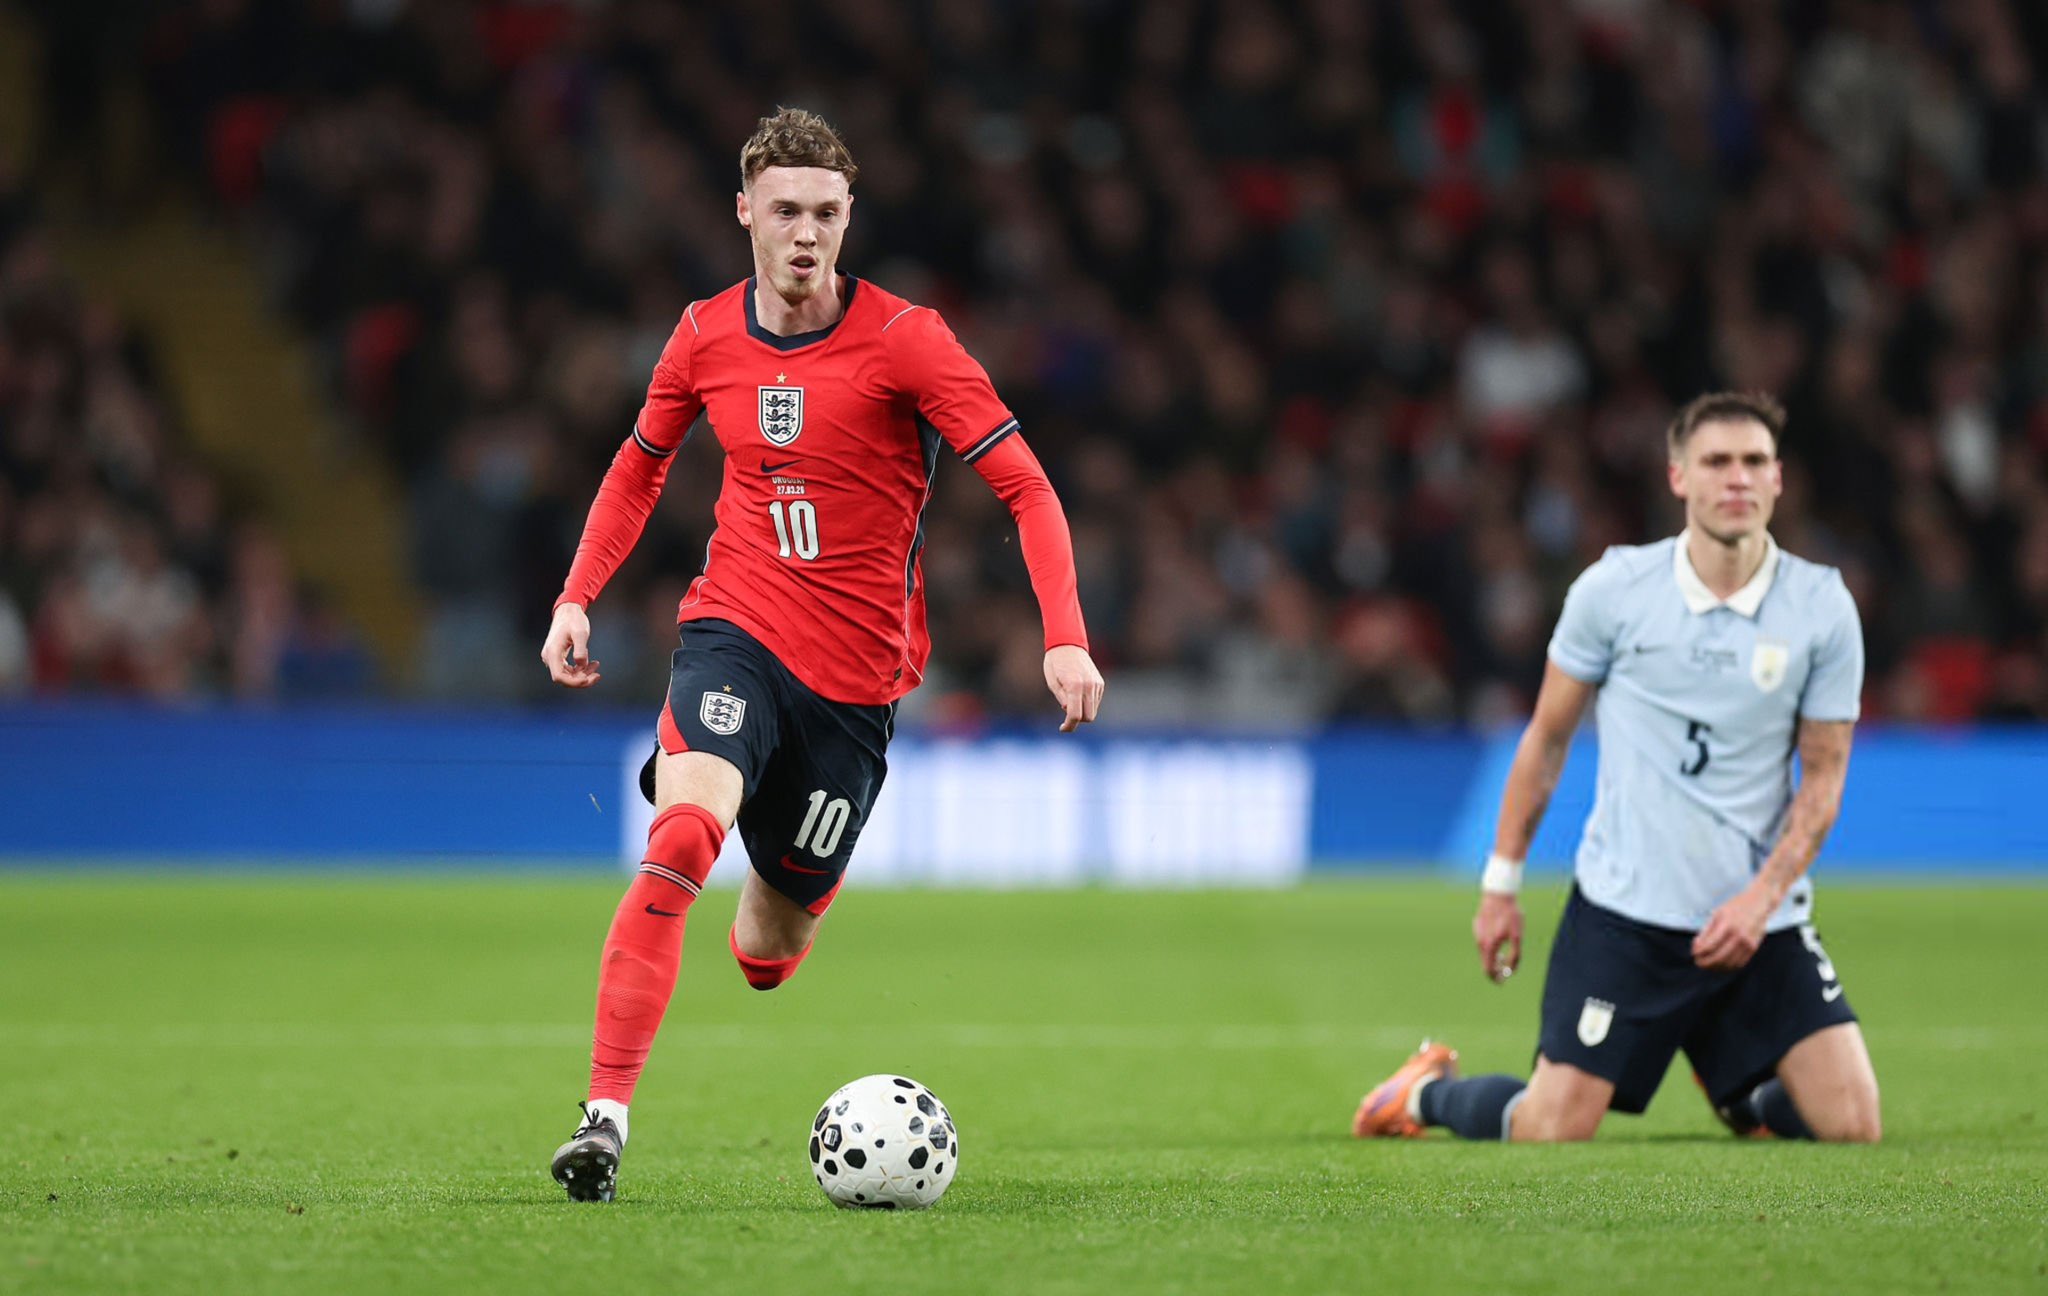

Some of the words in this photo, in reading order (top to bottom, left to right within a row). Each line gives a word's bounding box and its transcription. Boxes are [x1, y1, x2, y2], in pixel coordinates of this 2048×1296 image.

[768, 500, 820, 560] 10
[1680, 721, 1712, 775] 5
[793, 789, 851, 858] 10
